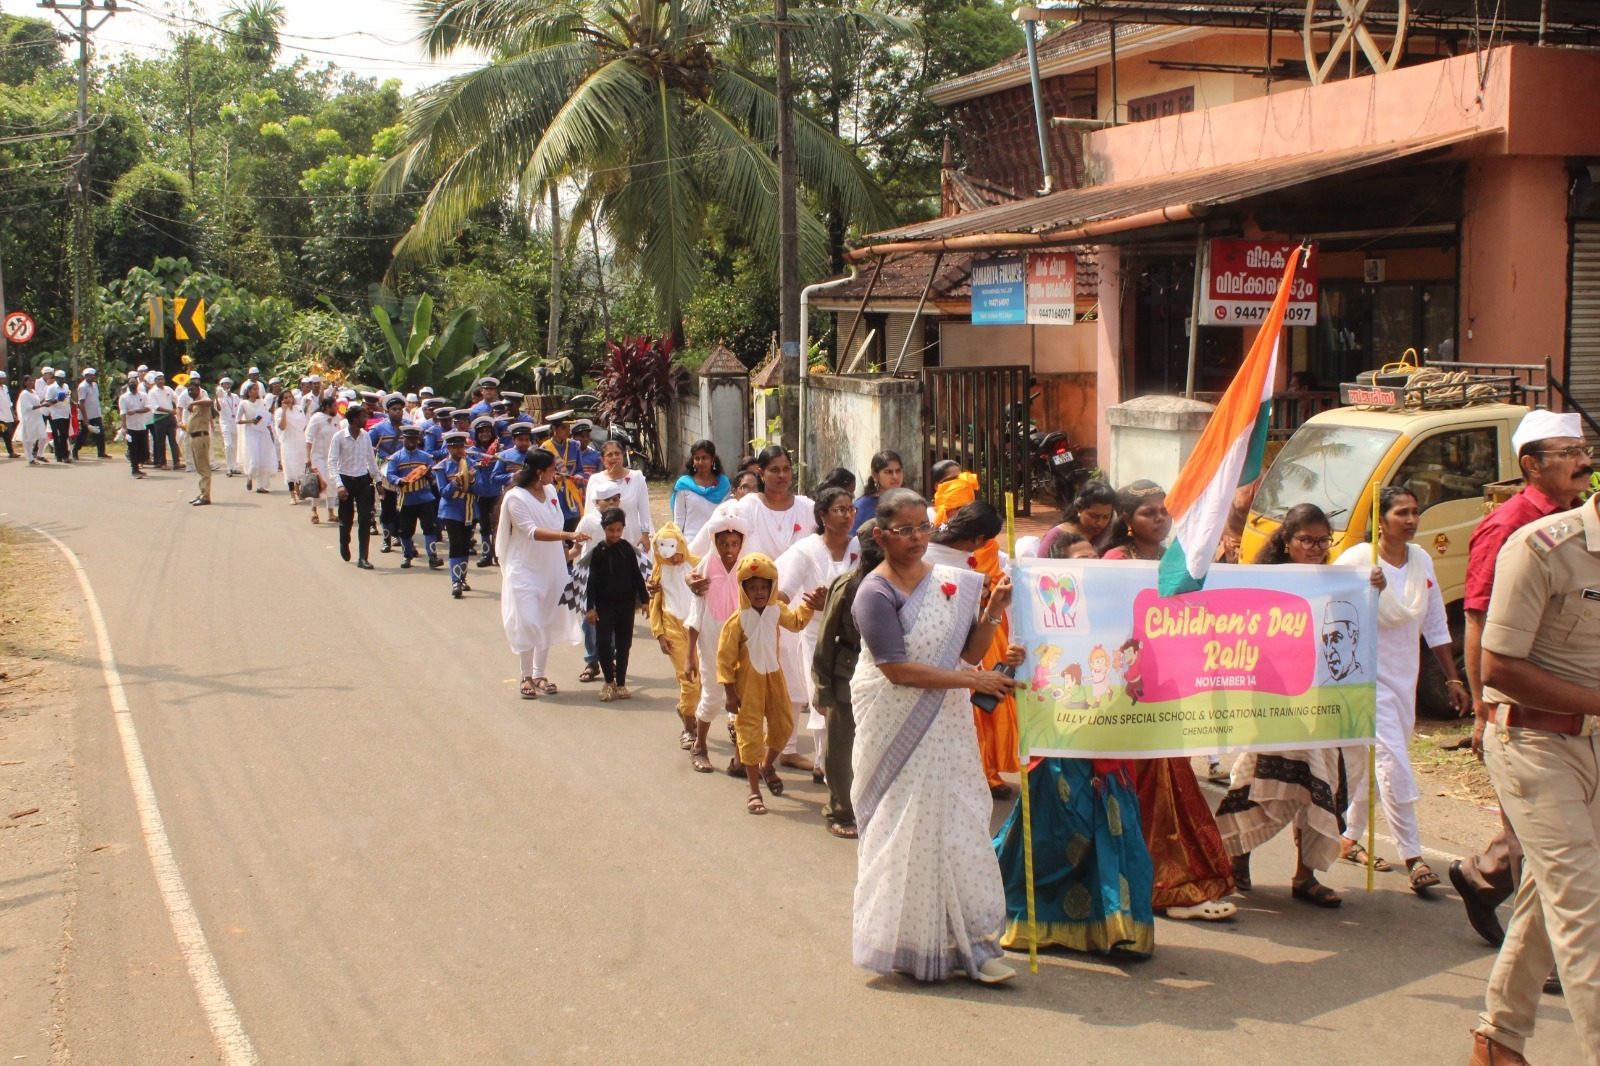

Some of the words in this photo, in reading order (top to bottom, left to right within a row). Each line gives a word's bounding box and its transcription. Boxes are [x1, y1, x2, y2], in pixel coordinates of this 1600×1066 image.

[1246, 245, 1290, 269] വിറക്
[1039, 308, 1071, 319] 9447164097
[1043, 610, 1077, 628] LILLY
[1145, 606, 1261, 639] Children's
[1267, 606, 1308, 638] Day
[1203, 639, 1259, 672] Rally
[1195, 676, 1245, 687] NOVEMBER
[1247, 675, 1257, 686] 14
[1057, 713, 1086, 724] LILLY
[1087, 714, 1118, 725] LIONS
[1120, 713, 1157, 724] SPECIAL
[1159, 711, 1196, 722] SCHOOL
[1198, 710, 1205, 721] &
[1208, 708, 1267, 720] VOCATIONAL
[1269, 706, 1309, 718] TRAINING
[1311, 704, 1341, 716] CENTER
[1182, 725, 1234, 736] CHENGANNUR
